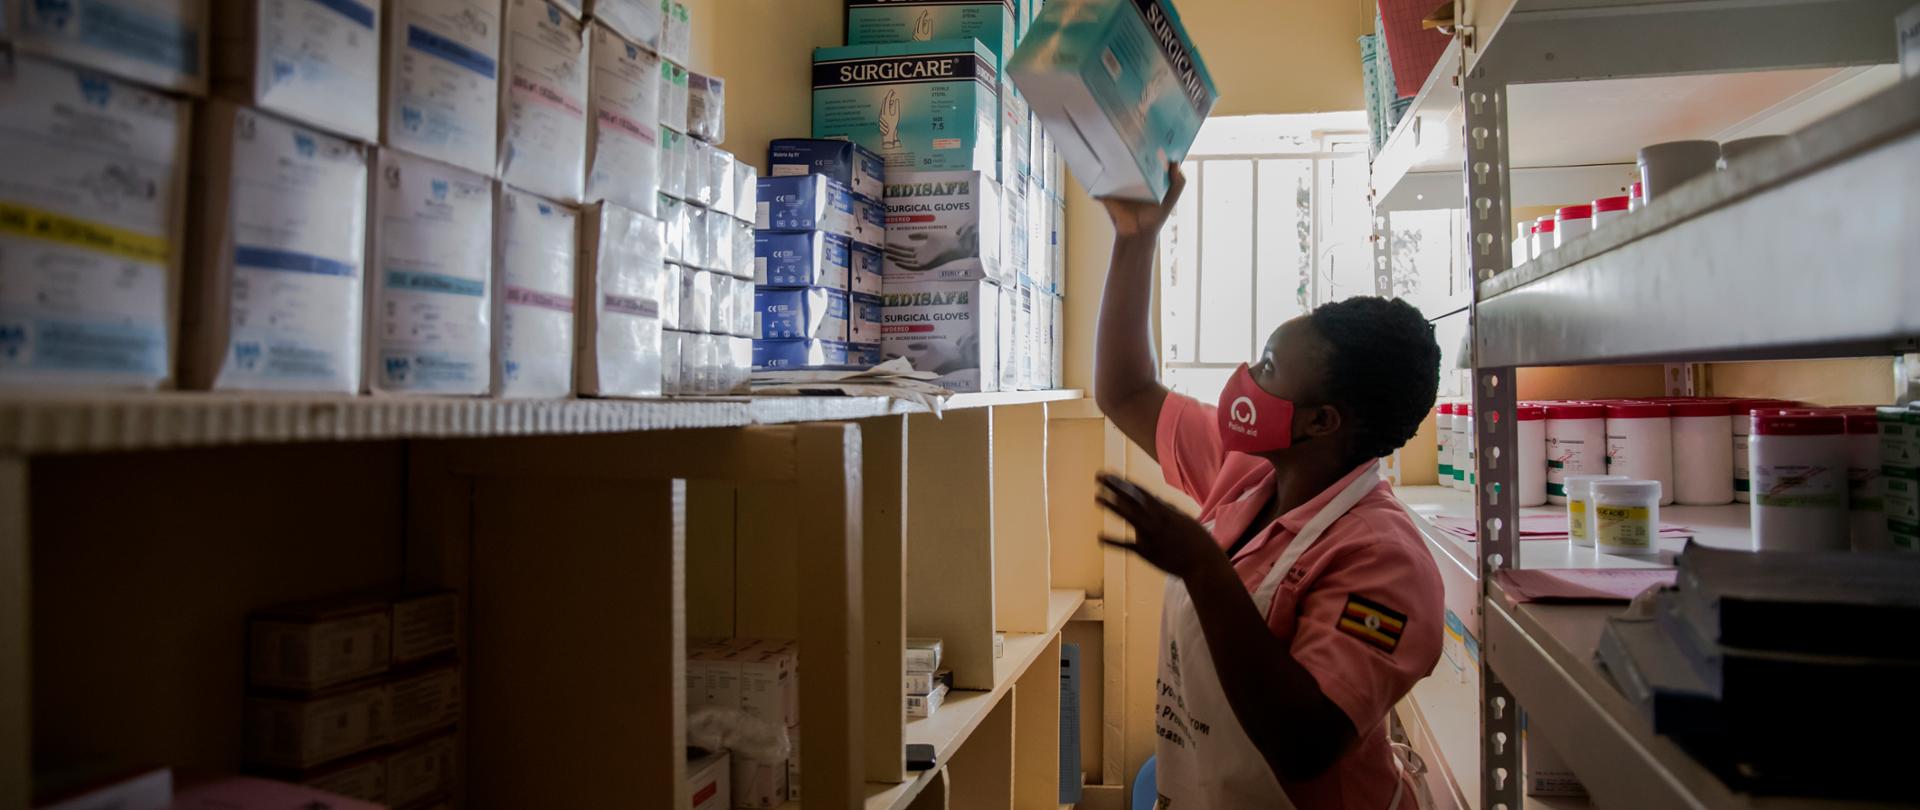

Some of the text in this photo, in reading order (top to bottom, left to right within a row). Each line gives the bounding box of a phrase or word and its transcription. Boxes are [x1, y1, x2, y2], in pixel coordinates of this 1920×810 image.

[1146, 3, 1206, 106] SURGICARE
[840, 59, 953, 82] SURGICARE
[931, 123, 945, 131] 7.5
[887, 202, 970, 213] SURGICAL GLOVES
[884, 312, 969, 322] SURGICAL GLOVES
[1229, 421, 1257, 437] Polish aid
